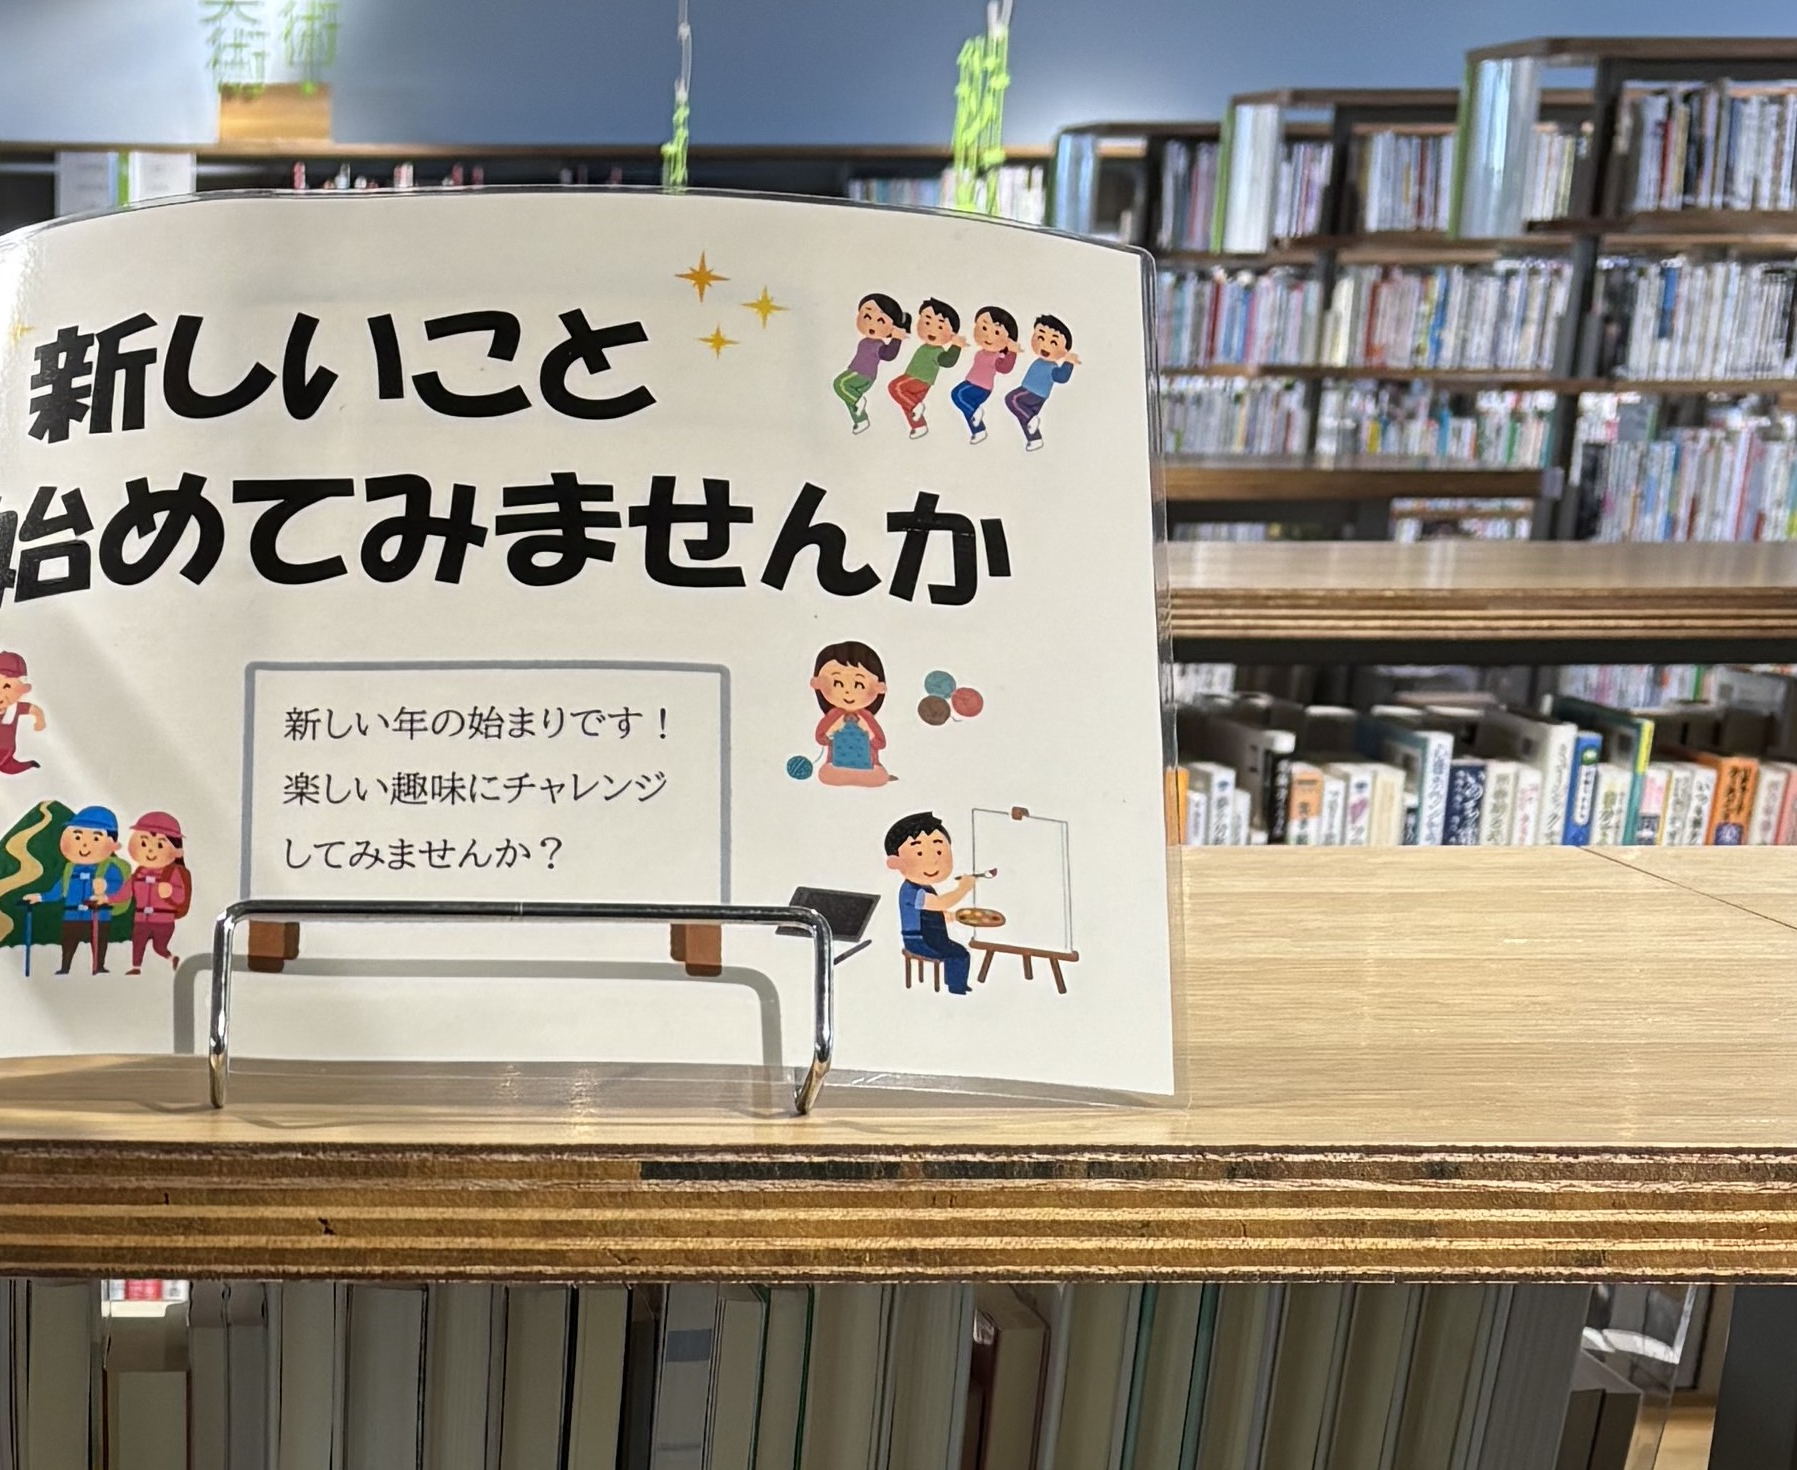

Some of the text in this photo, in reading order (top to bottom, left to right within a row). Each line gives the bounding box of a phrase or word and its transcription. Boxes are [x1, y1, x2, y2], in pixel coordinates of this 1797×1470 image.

[28, 308, 657, 445] 新しいこと
[283, 703, 671, 744] 新しい年の始まりです！
[283, 767, 668, 807] 楽しい趣味にチャレンジ
[283, 833, 561, 872] してみませんか？
